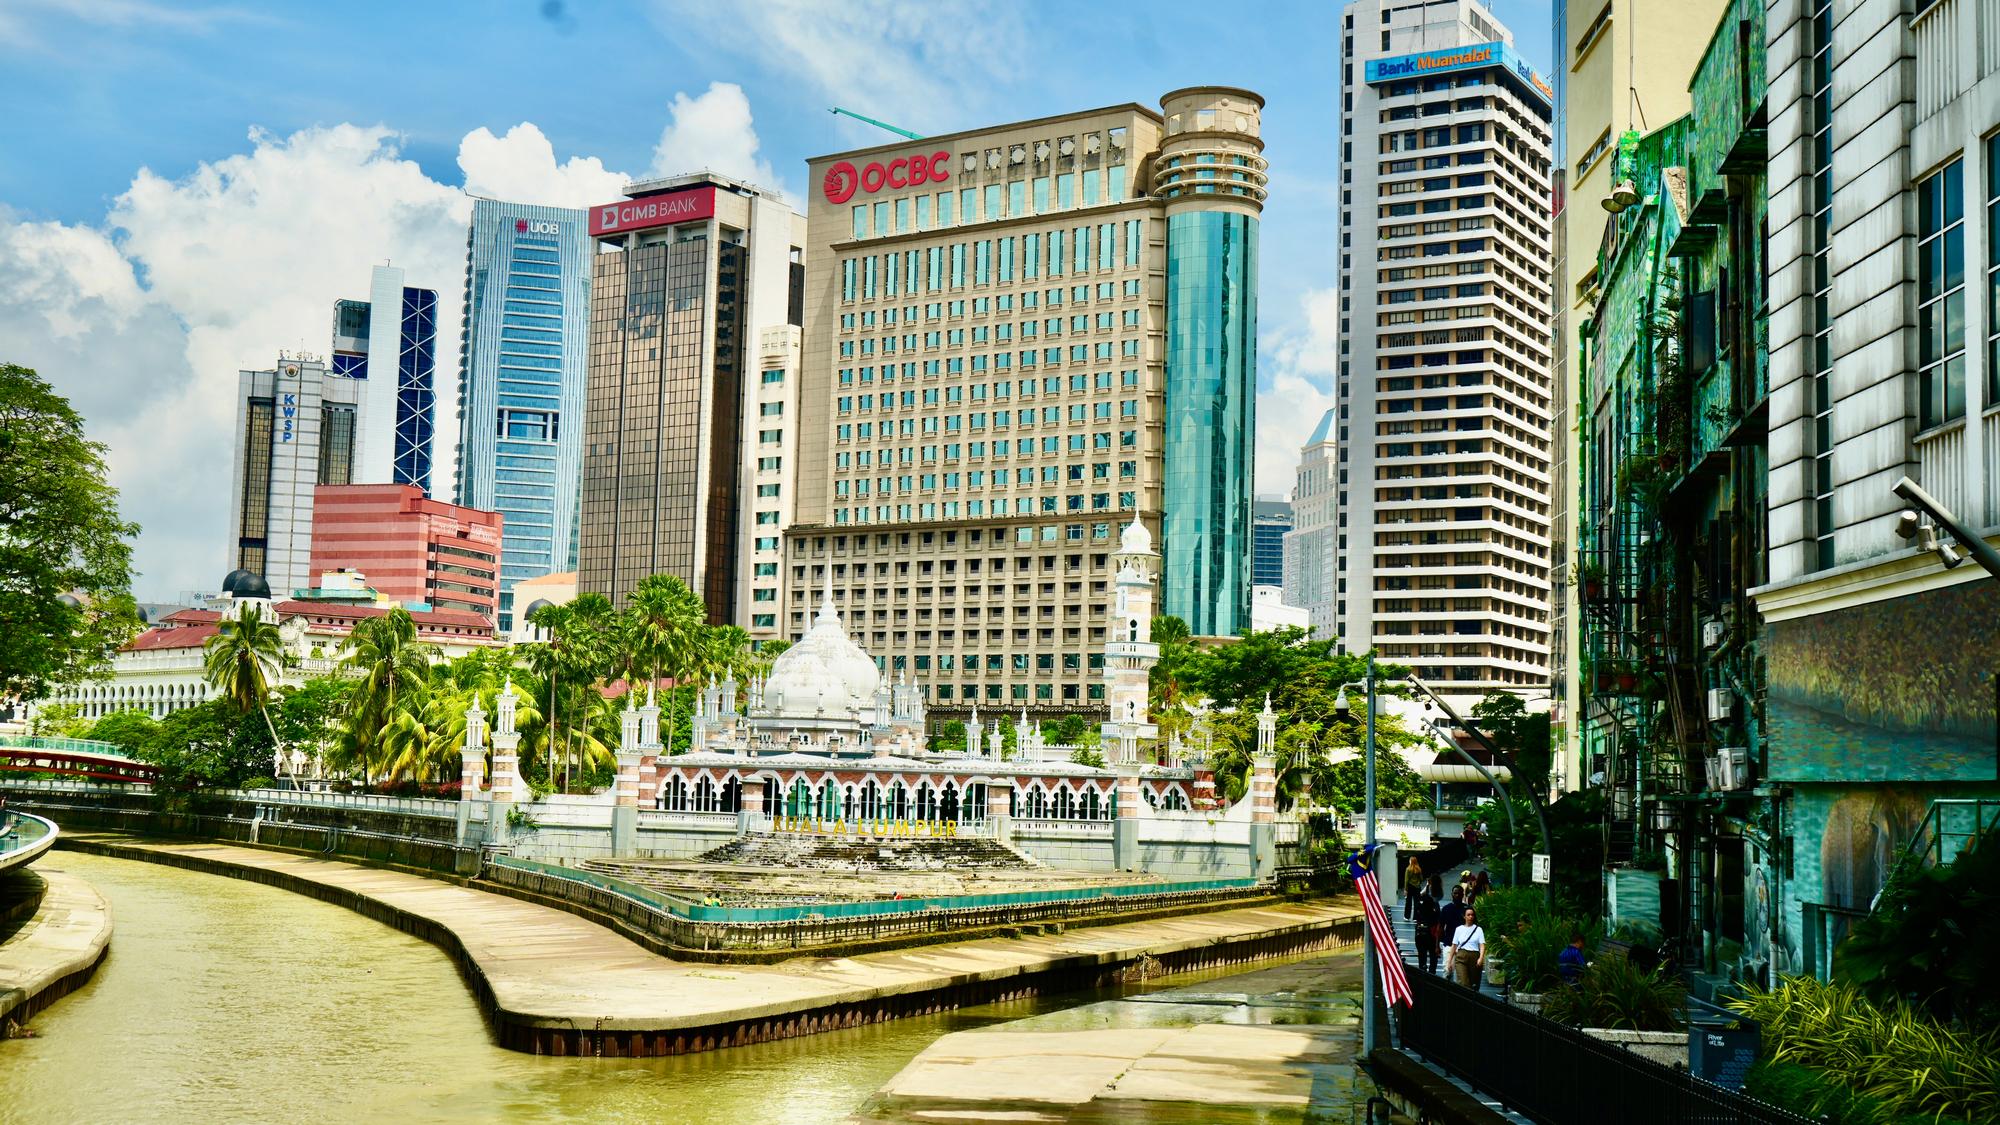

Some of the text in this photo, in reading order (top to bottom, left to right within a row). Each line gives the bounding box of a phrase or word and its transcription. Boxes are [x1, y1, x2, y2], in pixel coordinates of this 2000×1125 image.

[1378, 48, 1491, 77] Bank Muamalat
[861, 150, 951, 194] OCBC
[621, 197, 697, 223] CIMB BANK
[530, 222, 560, 235] UOB
[282, 394, 296, 443] KWSP
[773, 815, 957, 838] KUALA LUMPUR
